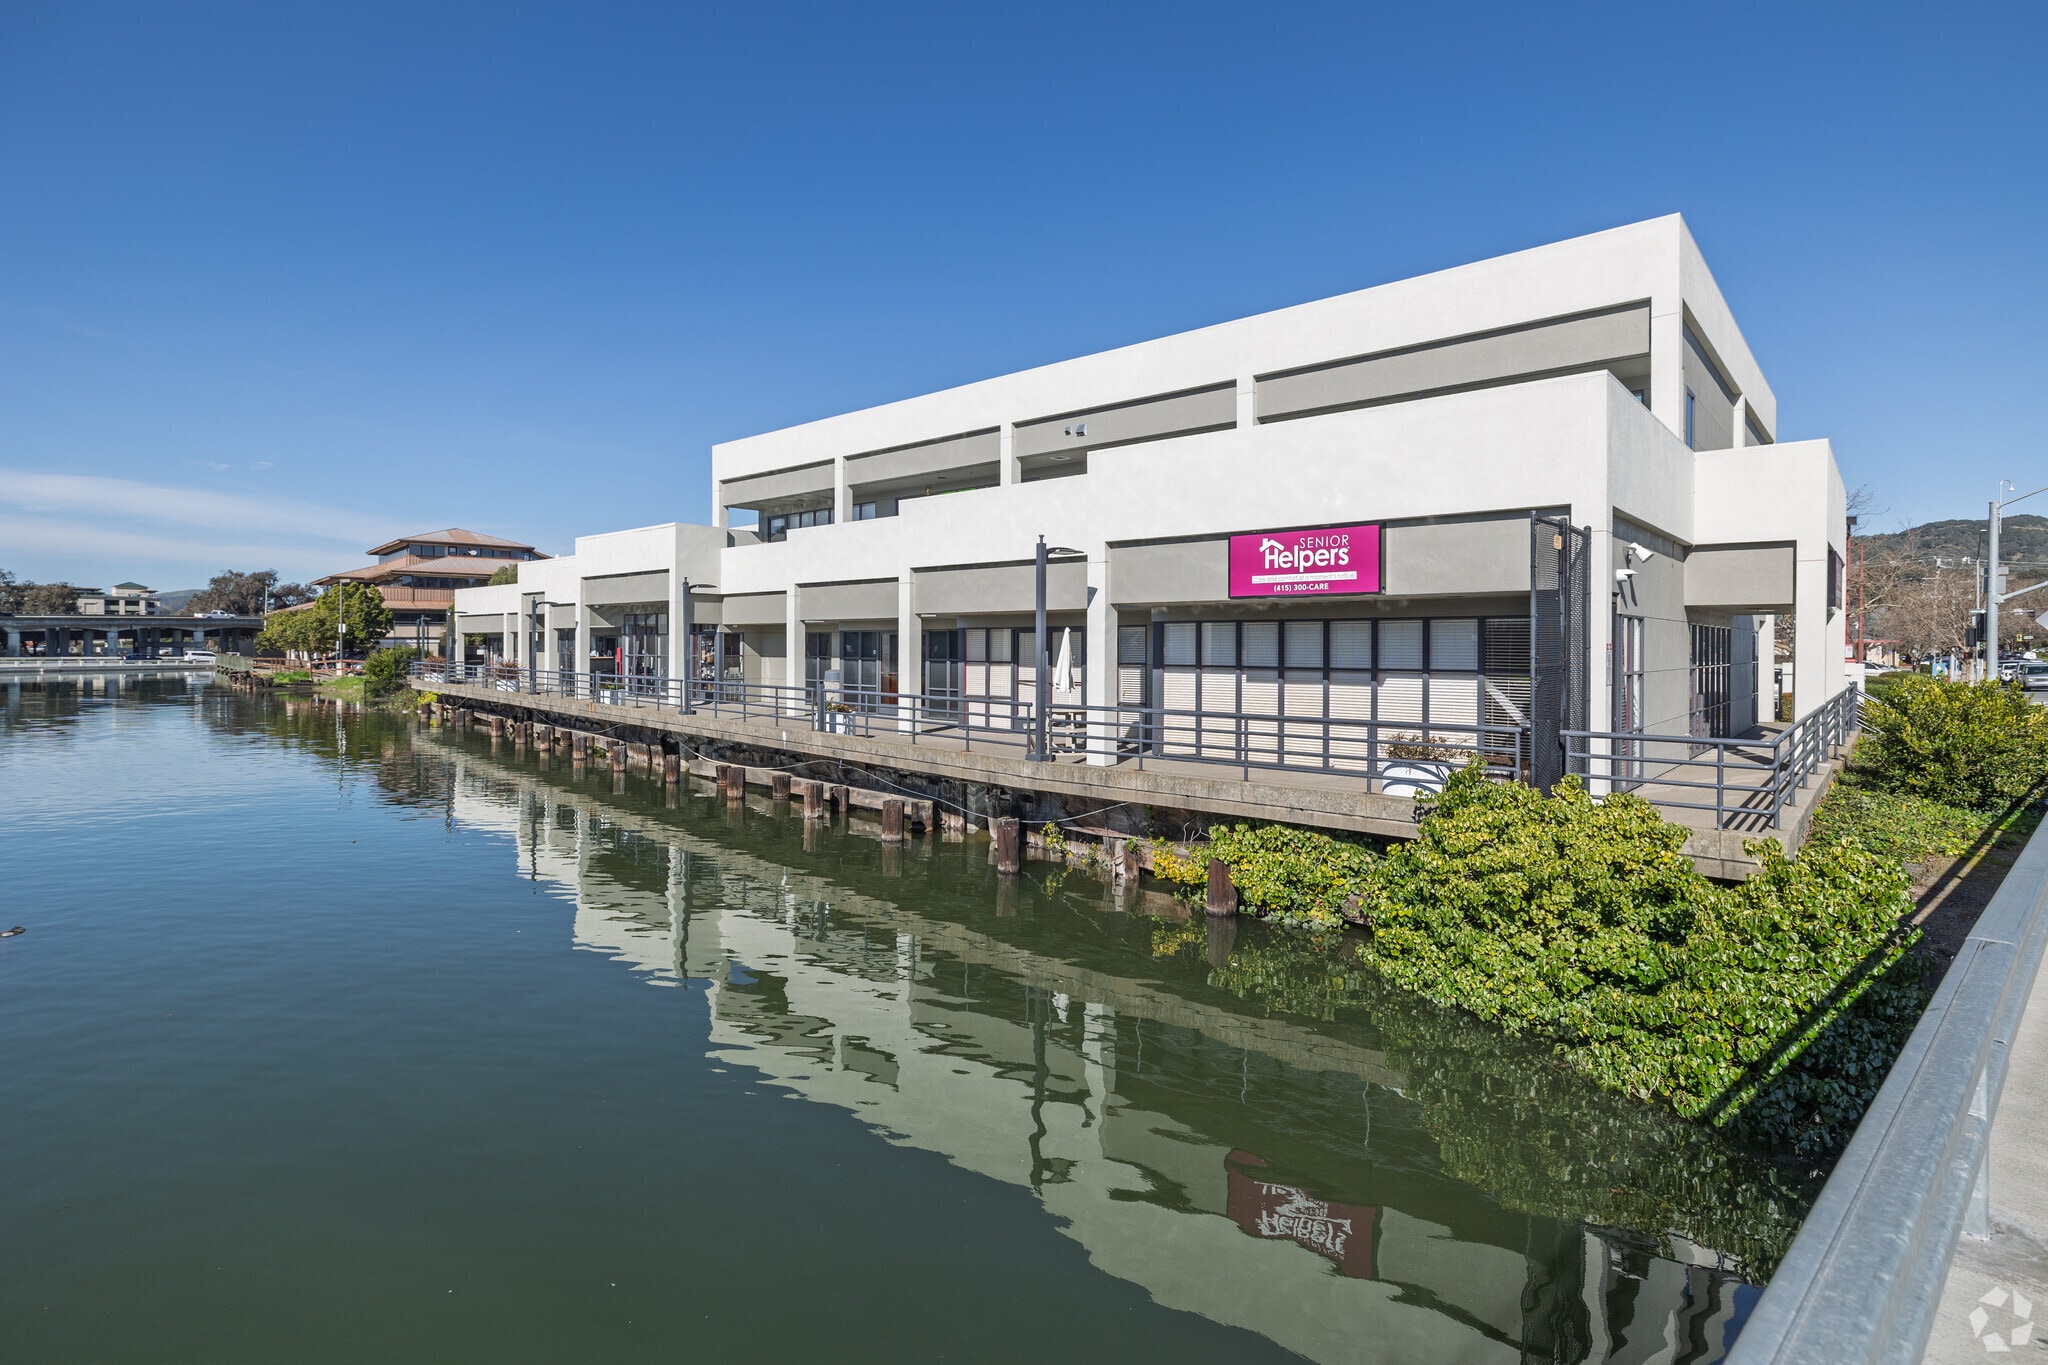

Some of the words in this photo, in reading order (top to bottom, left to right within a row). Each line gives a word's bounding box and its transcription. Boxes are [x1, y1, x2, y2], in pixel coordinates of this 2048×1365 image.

[1299, 534, 1349, 549] SENIOR
[1264, 544, 1349, 573] Helpers
[1273, 584, 1292, 592] (415)
[1293, 583, 1329, 591] 300-CARE
